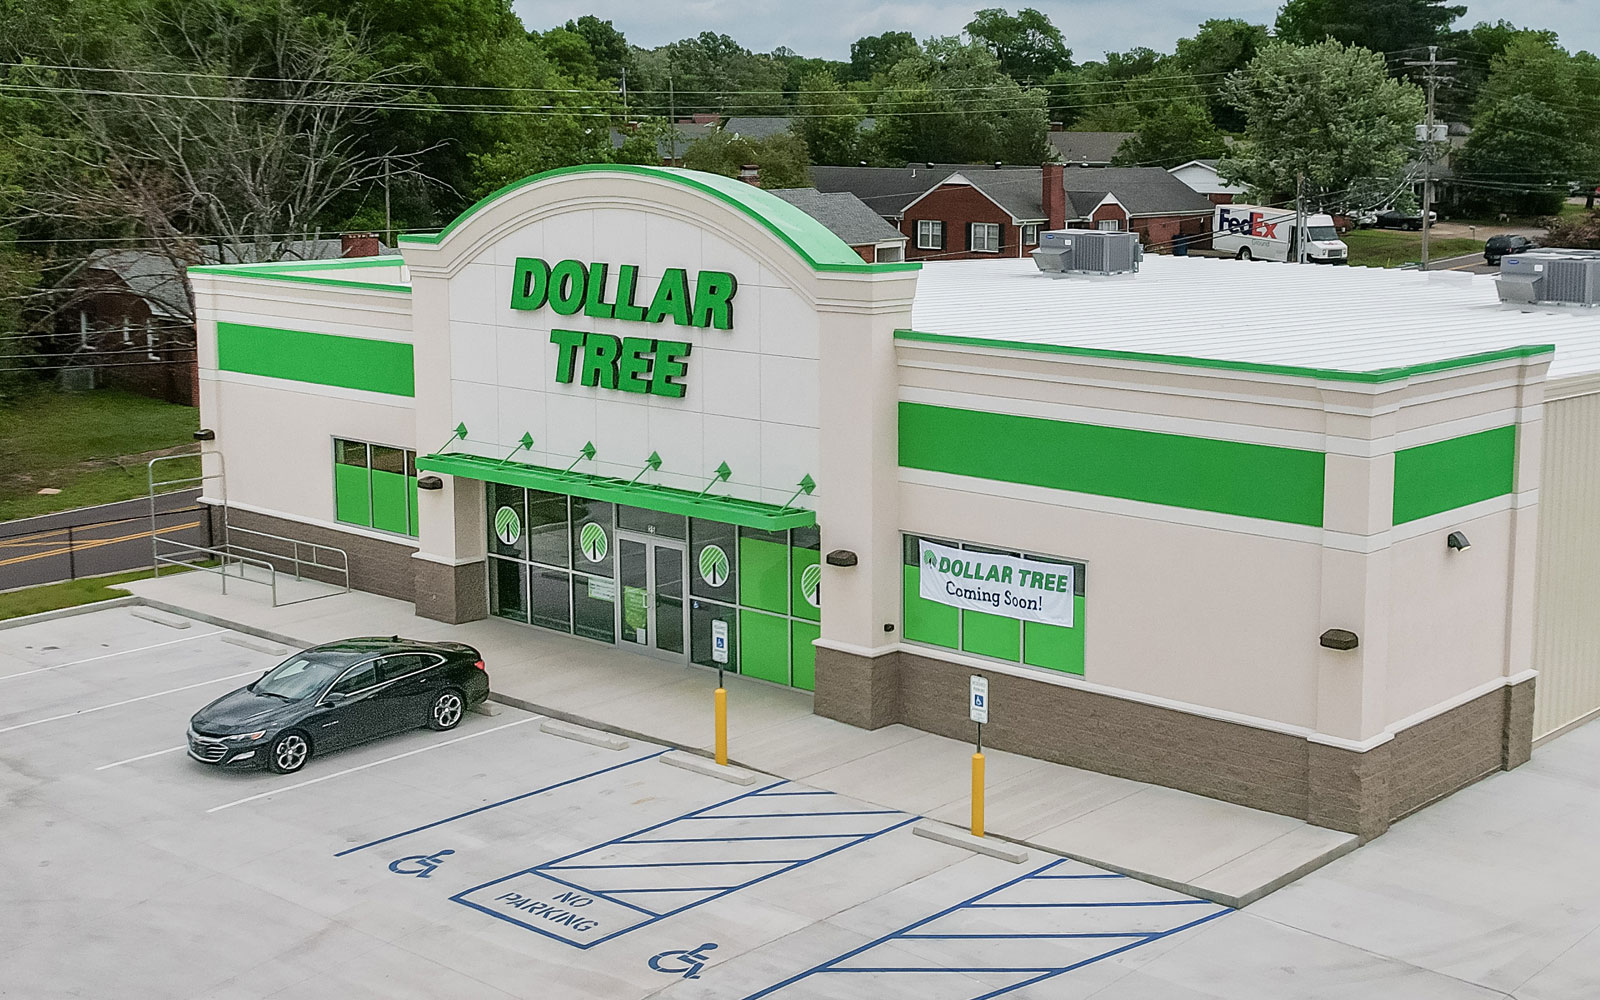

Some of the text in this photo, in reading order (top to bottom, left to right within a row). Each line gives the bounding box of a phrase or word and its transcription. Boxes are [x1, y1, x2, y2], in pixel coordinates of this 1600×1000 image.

[1219, 208, 1277, 239] FedEx
[510, 257, 737, 330] DOLLAR
[550, 329, 692, 398] TREE
[938, 556, 1068, 593] DOLLAR TREE
[945, 581, 1042, 611] Coming Soon!
[495, 892, 596, 932] PARKING
[552, 891, 594, 908] NO
